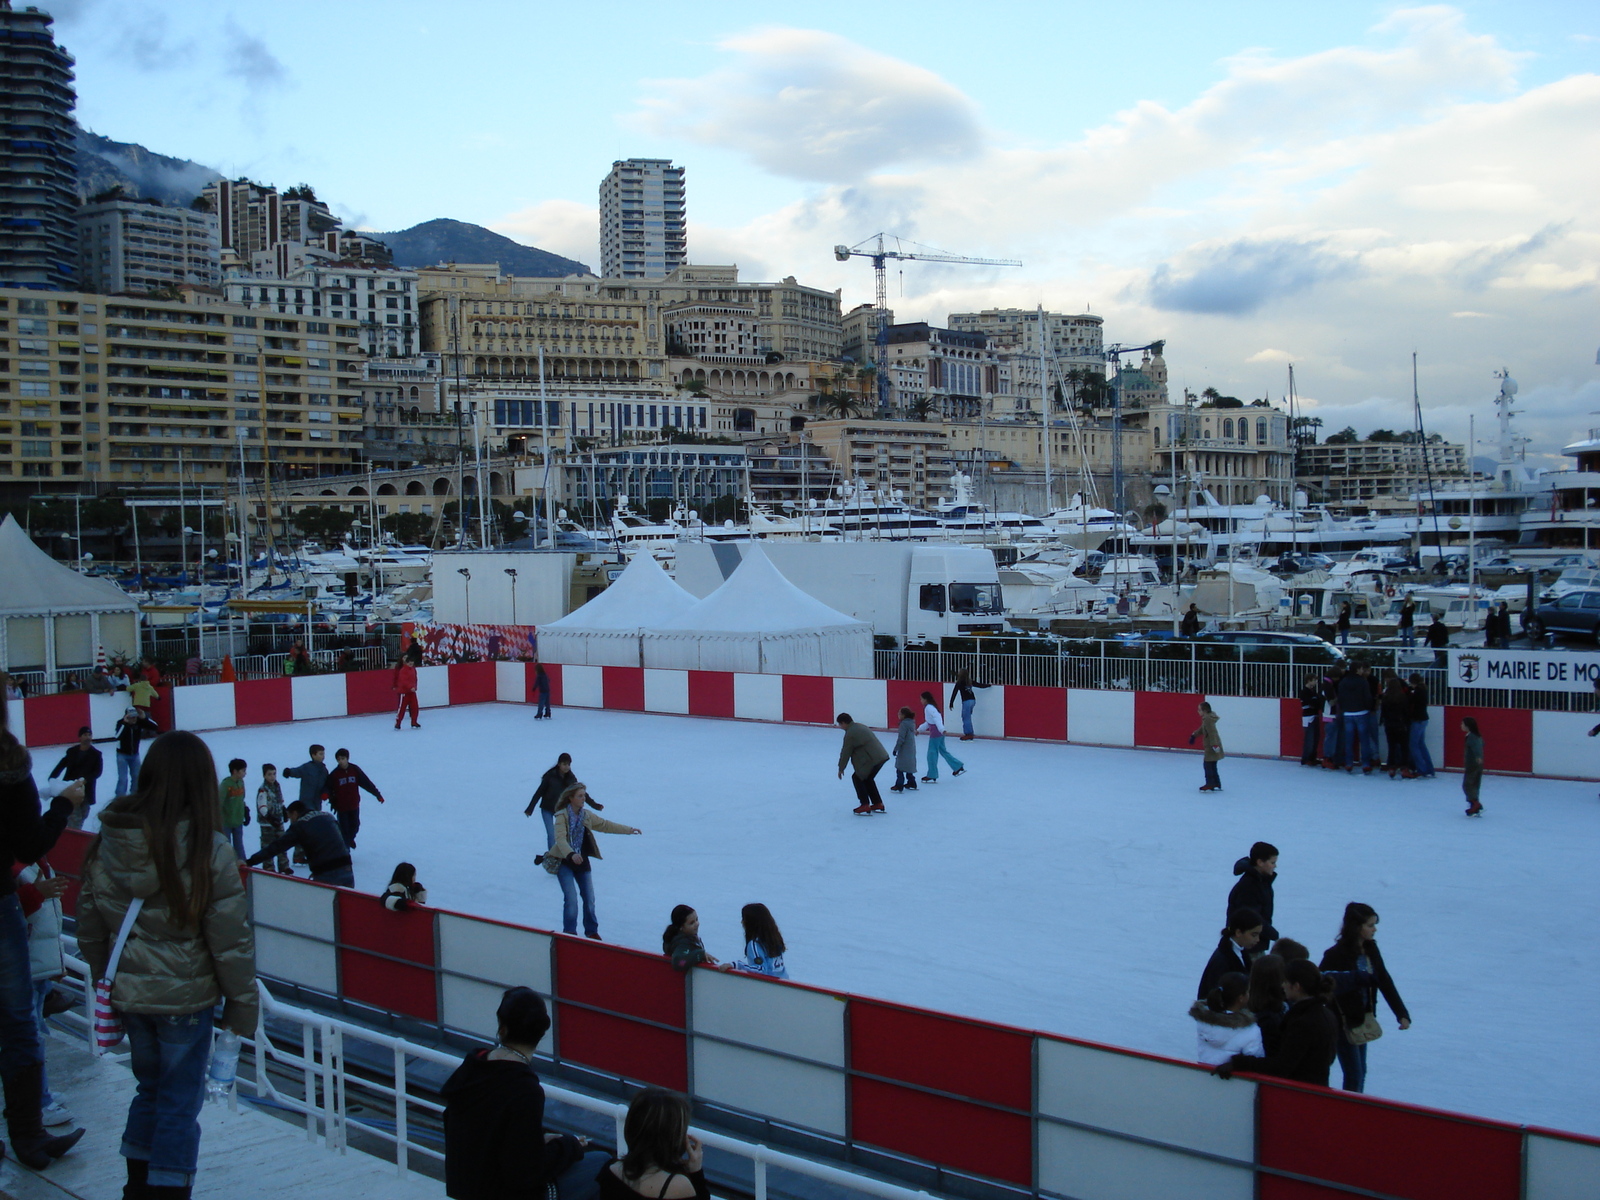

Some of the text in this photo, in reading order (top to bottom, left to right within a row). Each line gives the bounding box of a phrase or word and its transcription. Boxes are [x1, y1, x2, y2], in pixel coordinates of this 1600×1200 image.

[1487, 660, 1600, 682] MAIRIE DE MO
